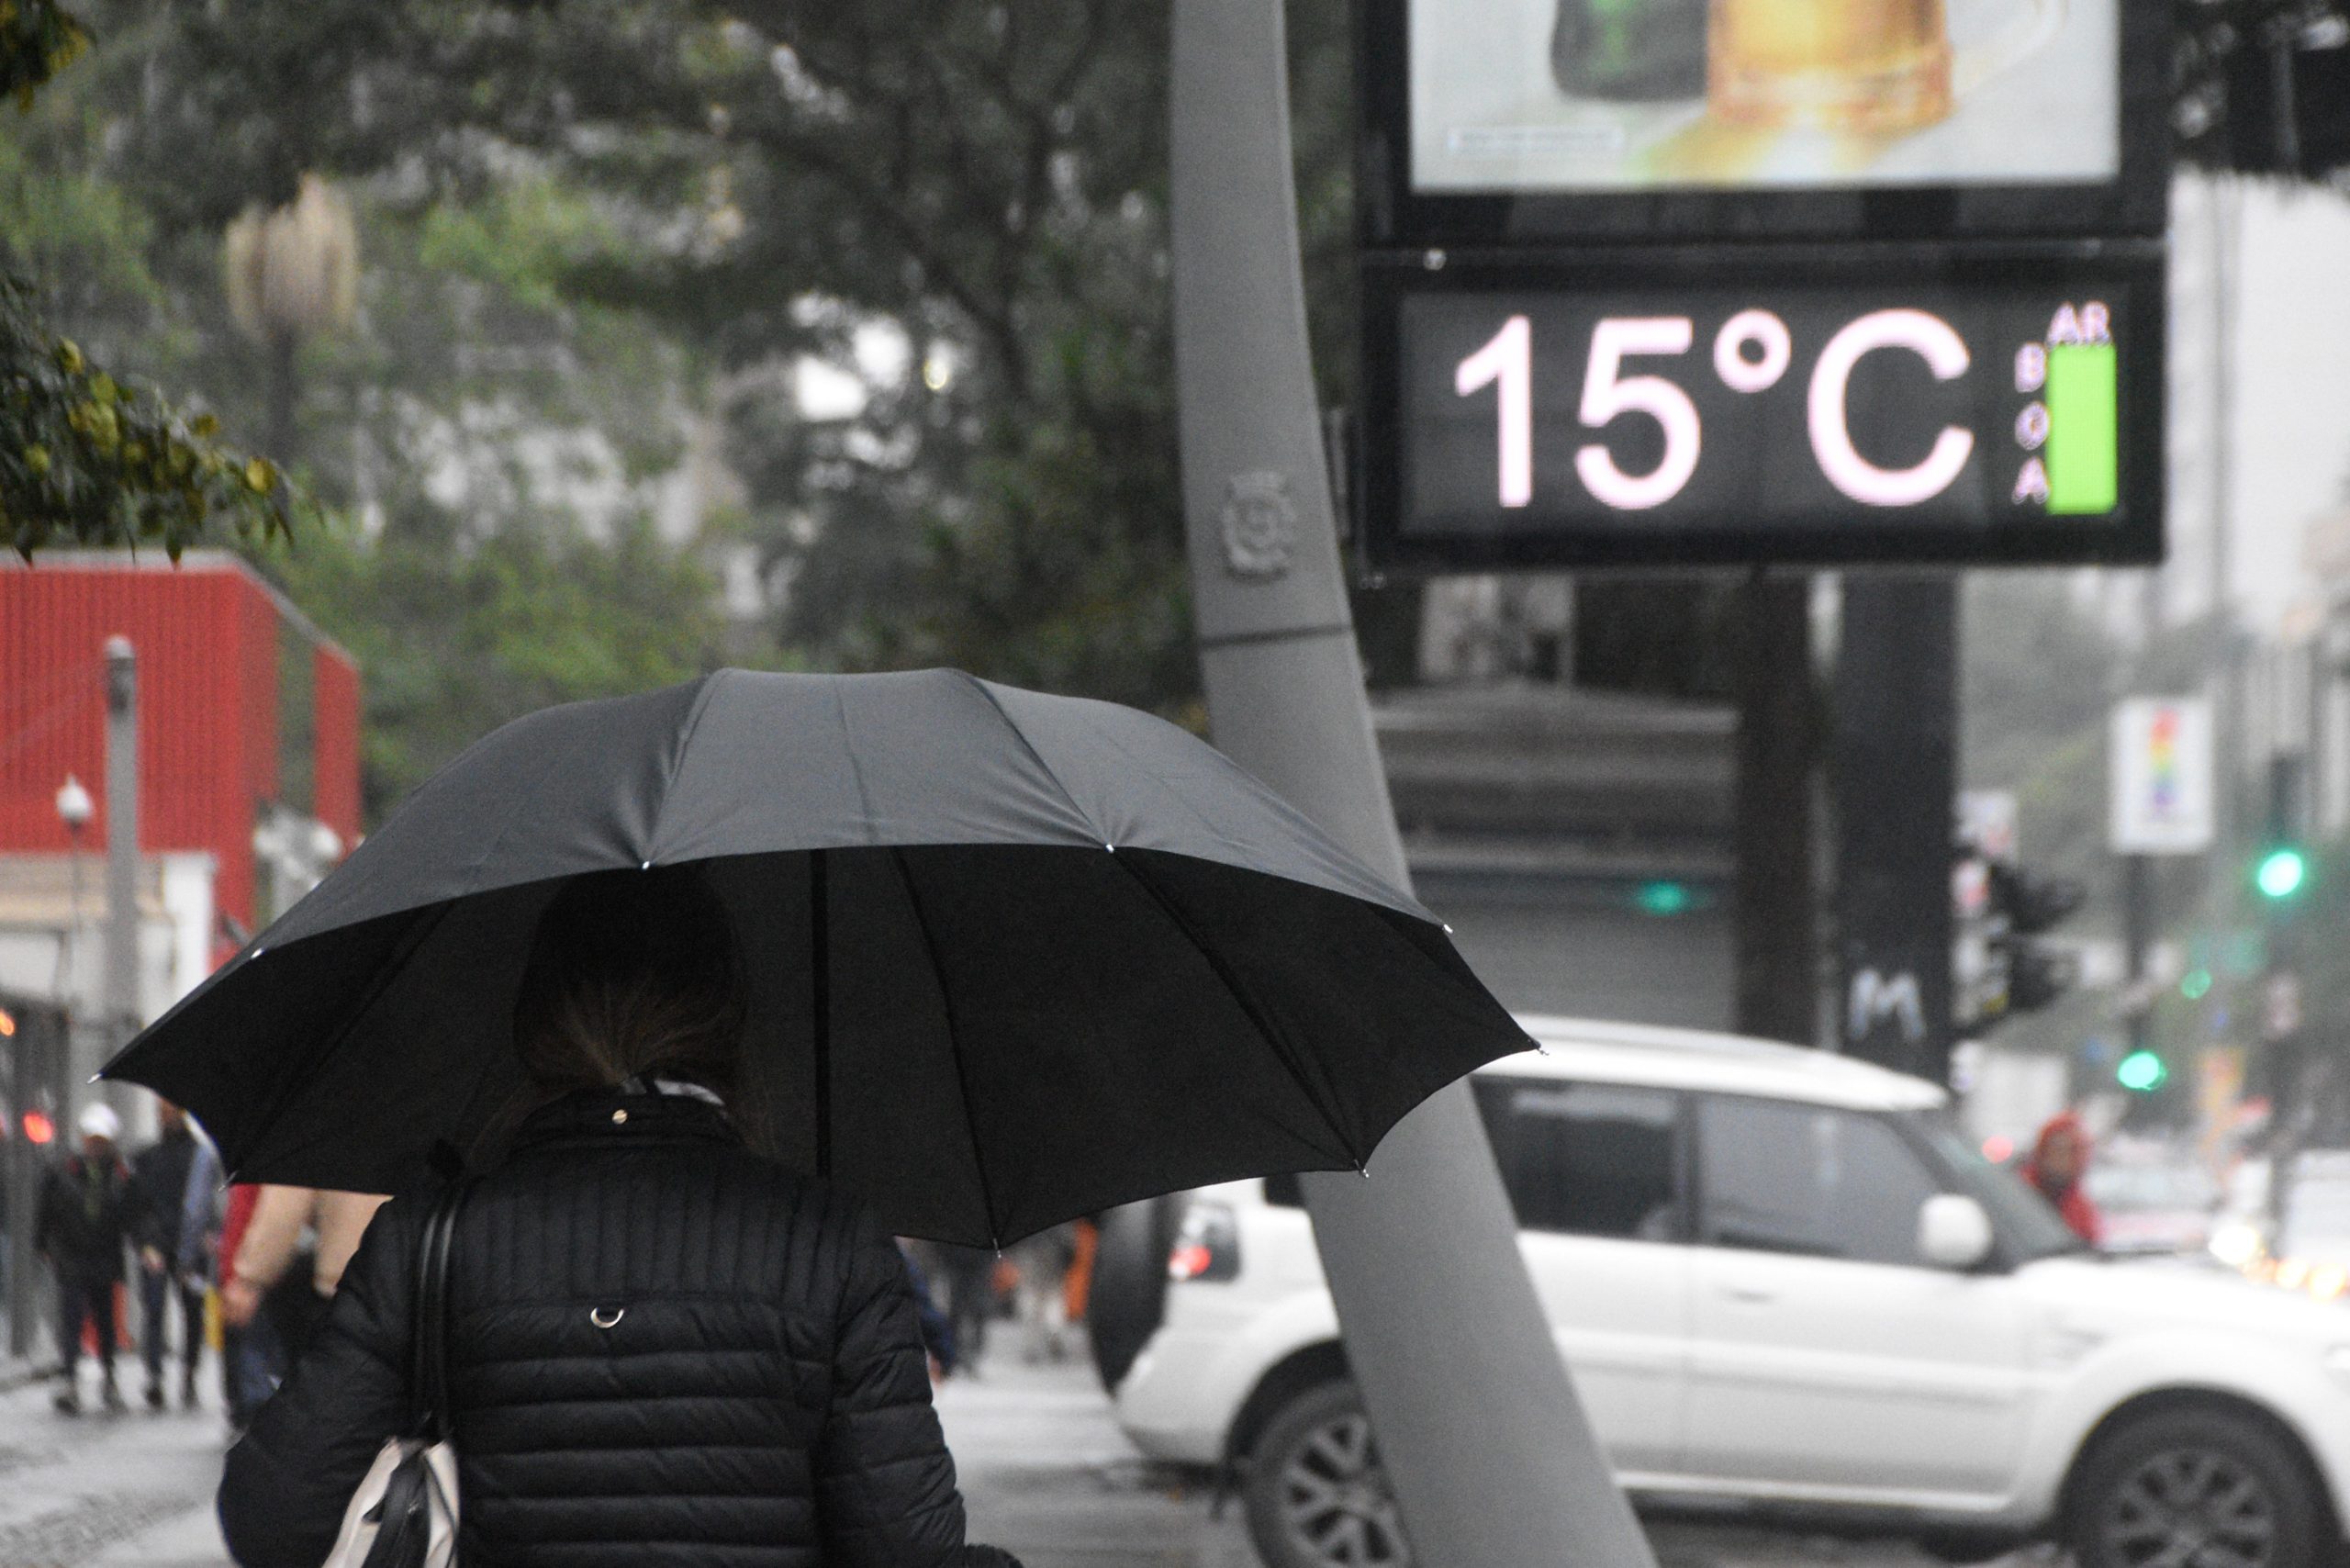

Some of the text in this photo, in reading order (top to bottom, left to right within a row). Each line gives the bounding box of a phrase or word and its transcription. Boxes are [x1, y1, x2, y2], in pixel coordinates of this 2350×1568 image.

[2046, 300, 2111, 346] AR
[2013, 342, 2050, 502] BOA
[1849, 968, 1926, 1039] M
